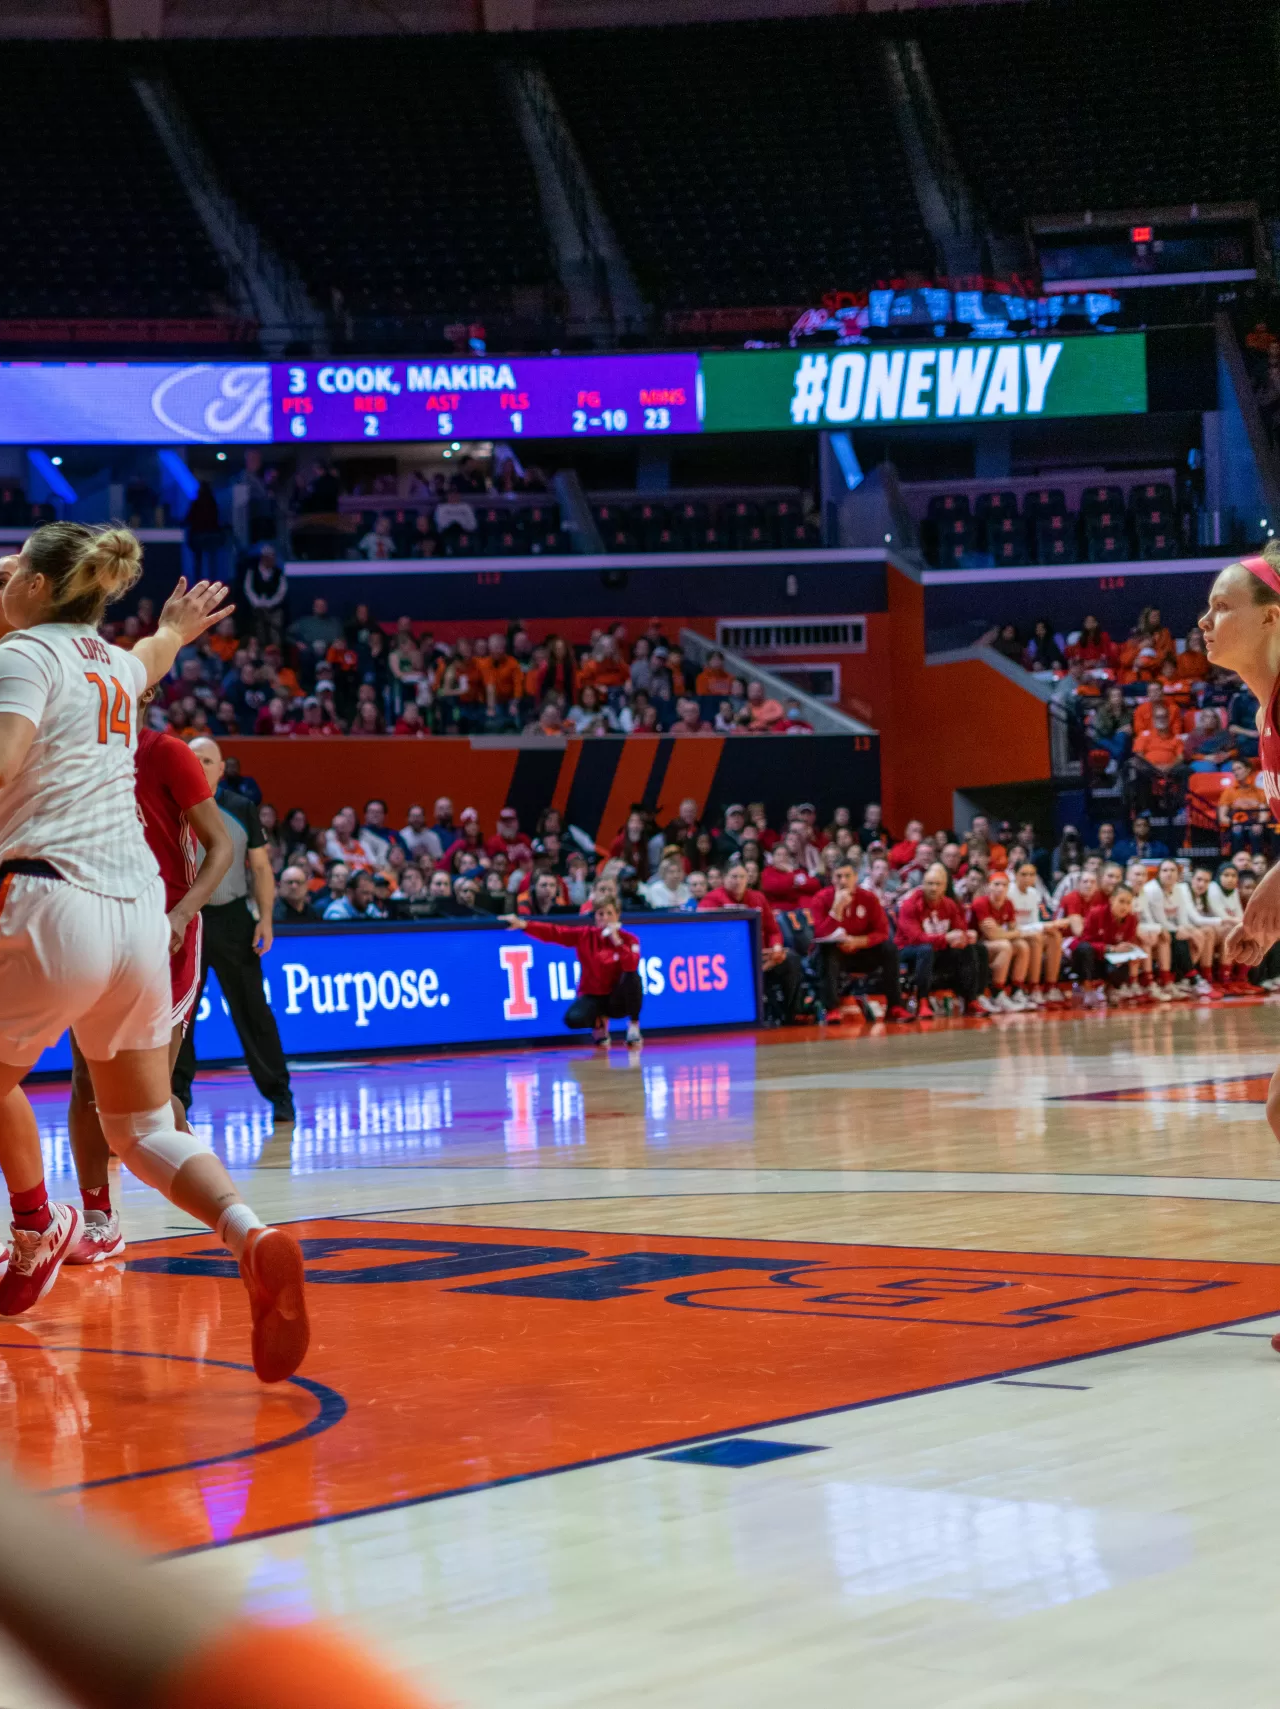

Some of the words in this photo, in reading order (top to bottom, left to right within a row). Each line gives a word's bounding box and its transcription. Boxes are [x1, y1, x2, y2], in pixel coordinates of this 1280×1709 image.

[288, 368, 307, 394] 3
[317, 367, 402, 395] COOK,
[406, 364, 517, 391] MAKIRA
[790, 342, 1064, 424] #ONEWAY
[282, 397, 314, 413] PTS
[425, 394, 460, 411] AST
[500, 393, 530, 410] FLS
[577, 391, 601, 408] FG
[290, 416, 307, 438] 6
[363, 415, 379, 437] 2
[437, 413, 453, 435] 5
[510, 411, 523, 433] 1
[572, 409, 628, 432] 2-10
[643, 408, 671, 430] 23
[71, 637, 112, 665] LOPES
[83, 671, 132, 749] 14
[669, 954, 728, 993] GIES
[282, 963, 451, 1027] Purpose.
